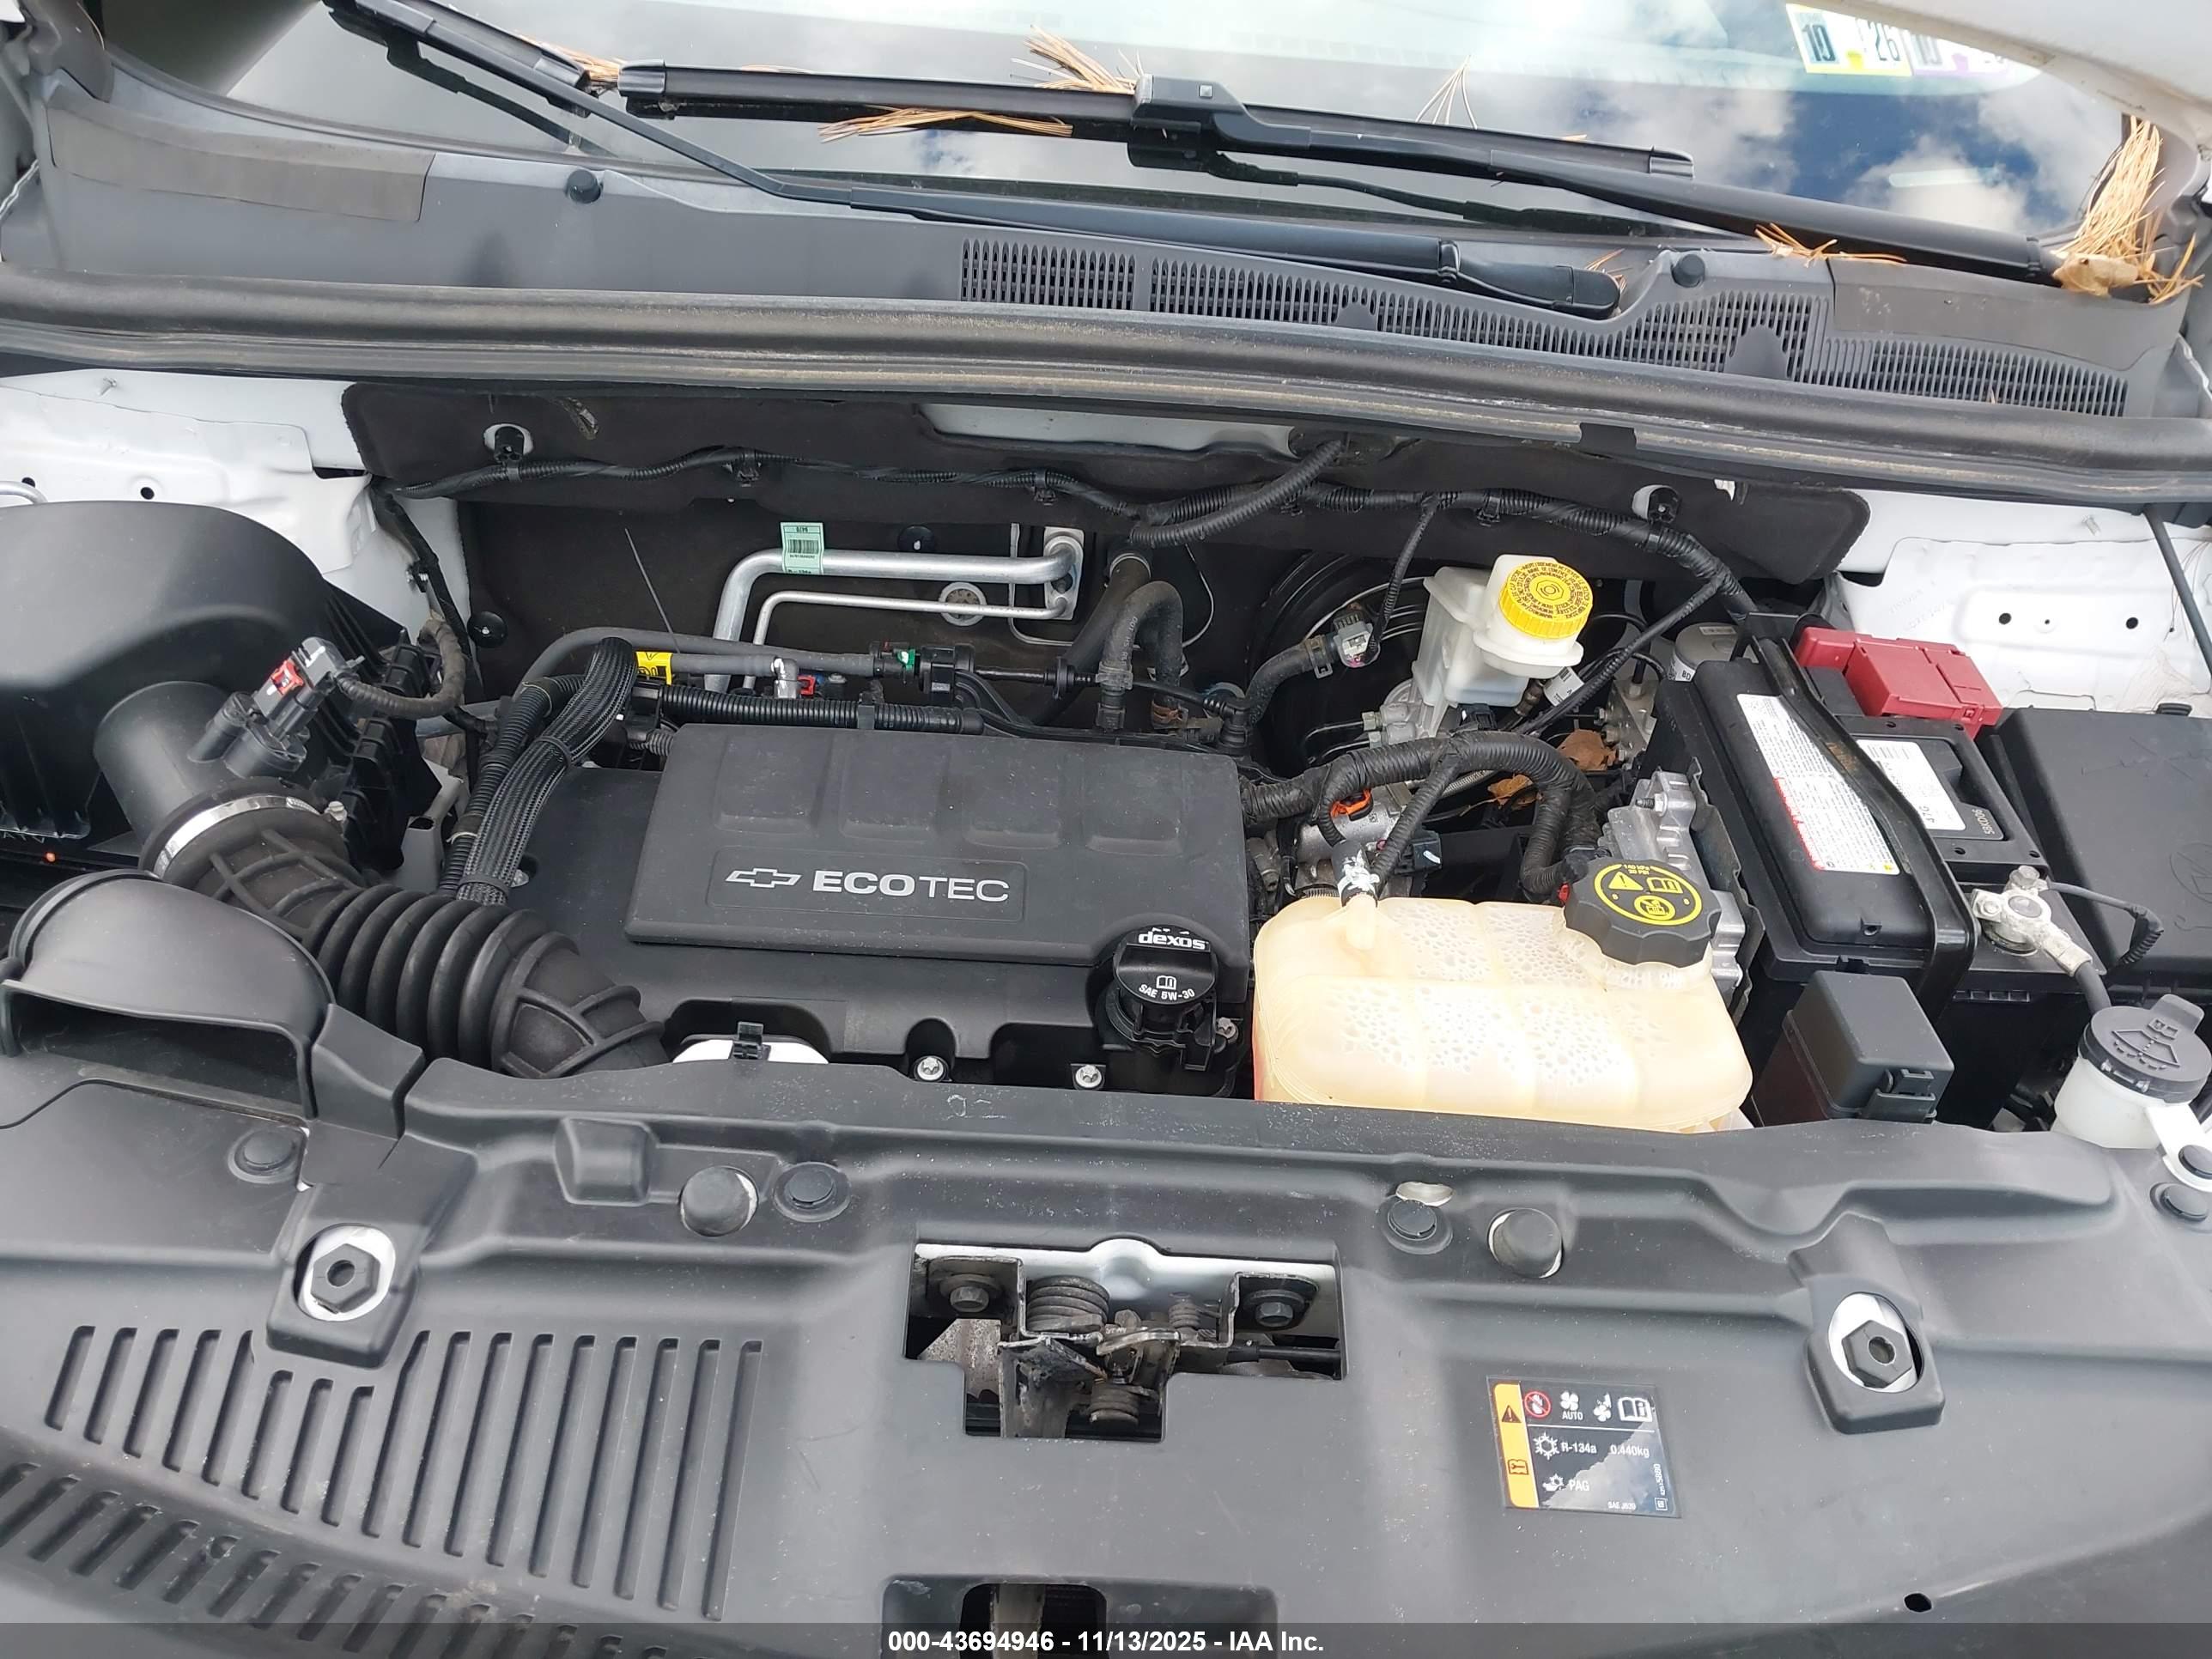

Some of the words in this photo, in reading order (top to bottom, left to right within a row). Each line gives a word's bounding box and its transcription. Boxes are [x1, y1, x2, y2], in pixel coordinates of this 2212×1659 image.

[812, 870, 1010, 902] ECOTEC
[1138, 931, 1206, 950] dexos
[1139, 984, 1158, 998] SAE
[1161, 988, 1195, 1000] 5W-30
[1561, 1411, 1583, 1420] AUTO
[1559, 1442, 1597, 1454] R-134a
[1609, 1444, 1650, 1458] 0.440kg
[1569, 1480, 1590, 1492] PAG
